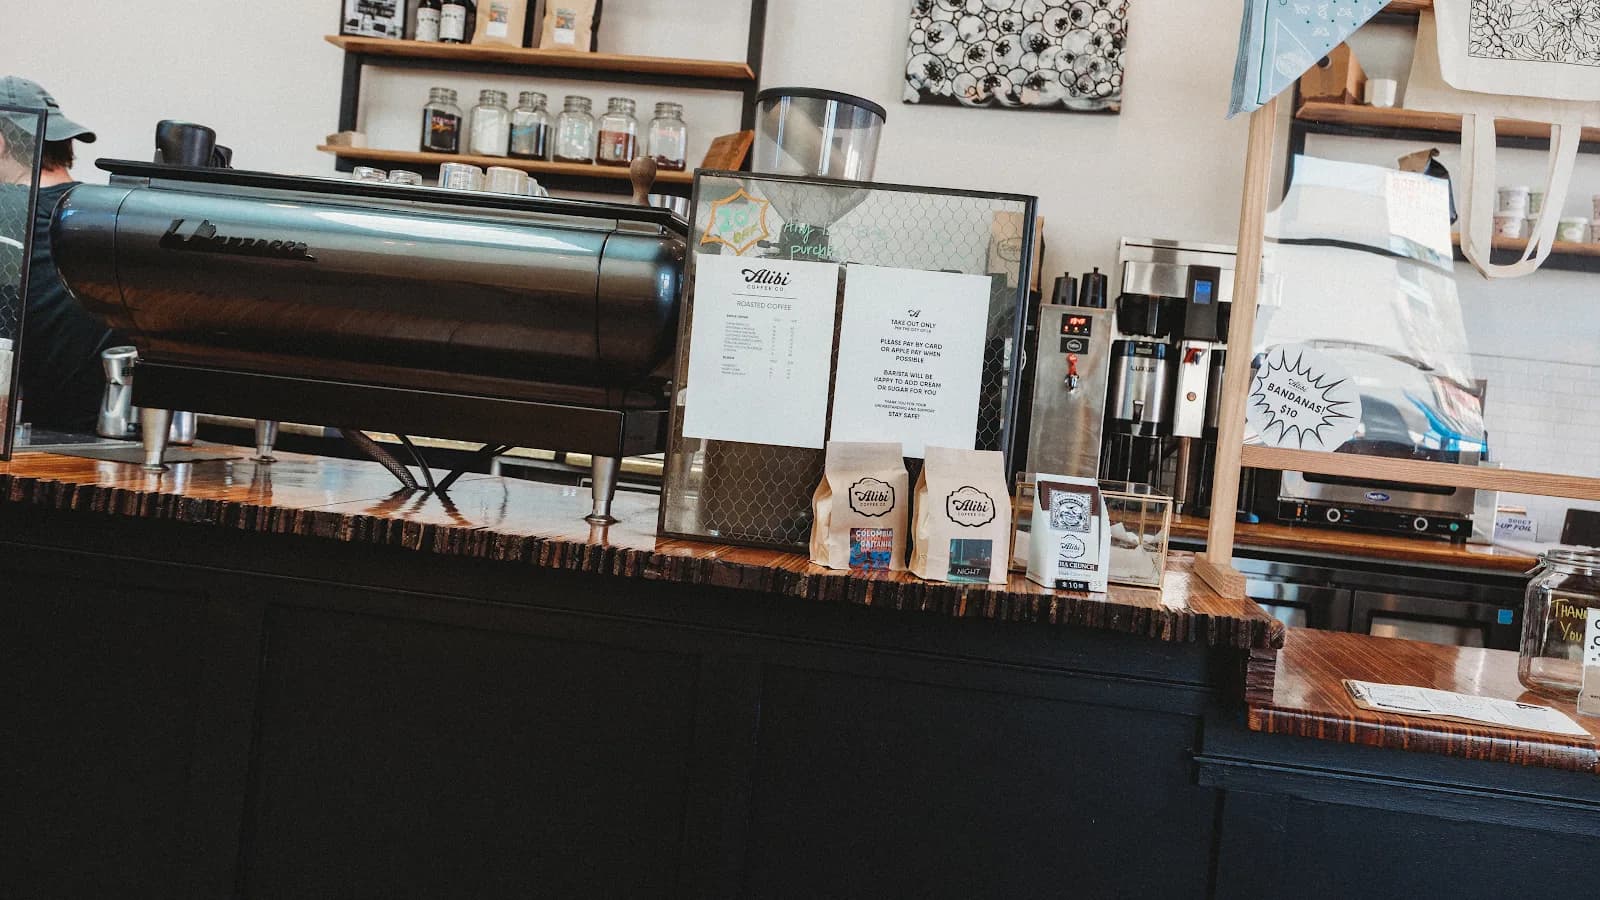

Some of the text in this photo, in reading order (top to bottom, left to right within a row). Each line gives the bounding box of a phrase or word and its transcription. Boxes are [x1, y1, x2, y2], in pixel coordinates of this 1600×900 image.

[741, 268, 792, 286] Alibi
[736, 300, 793, 311] ROASTED COFFEE
[906, 320, 919, 328] OUT
[880, 338, 902, 346] PLEASE
[924, 342, 943, 350] CARD
[891, 347, 910, 355] APPLE
[923, 350, 941, 358] WHEN
[895, 355, 924, 364] POSSIBLE
[883, 369, 909, 378] BARISTA
[873, 376, 894, 384] HAPPY
[919, 381, 942, 389] CREAM
[887, 385, 909, 393] SUGAR
[909, 387, 922, 395] FOR
[1267, 382, 1326, 415] BANDANAS!
[903, 412, 920, 420] SAFE!
[1280, 404, 1298, 418] $10
[854, 489, 891, 502] Alibi
[952, 499, 990, 512] Alibi
[856, 529, 893, 537] COLOMBIA
[956, 567, 982, 576] NIGHT
